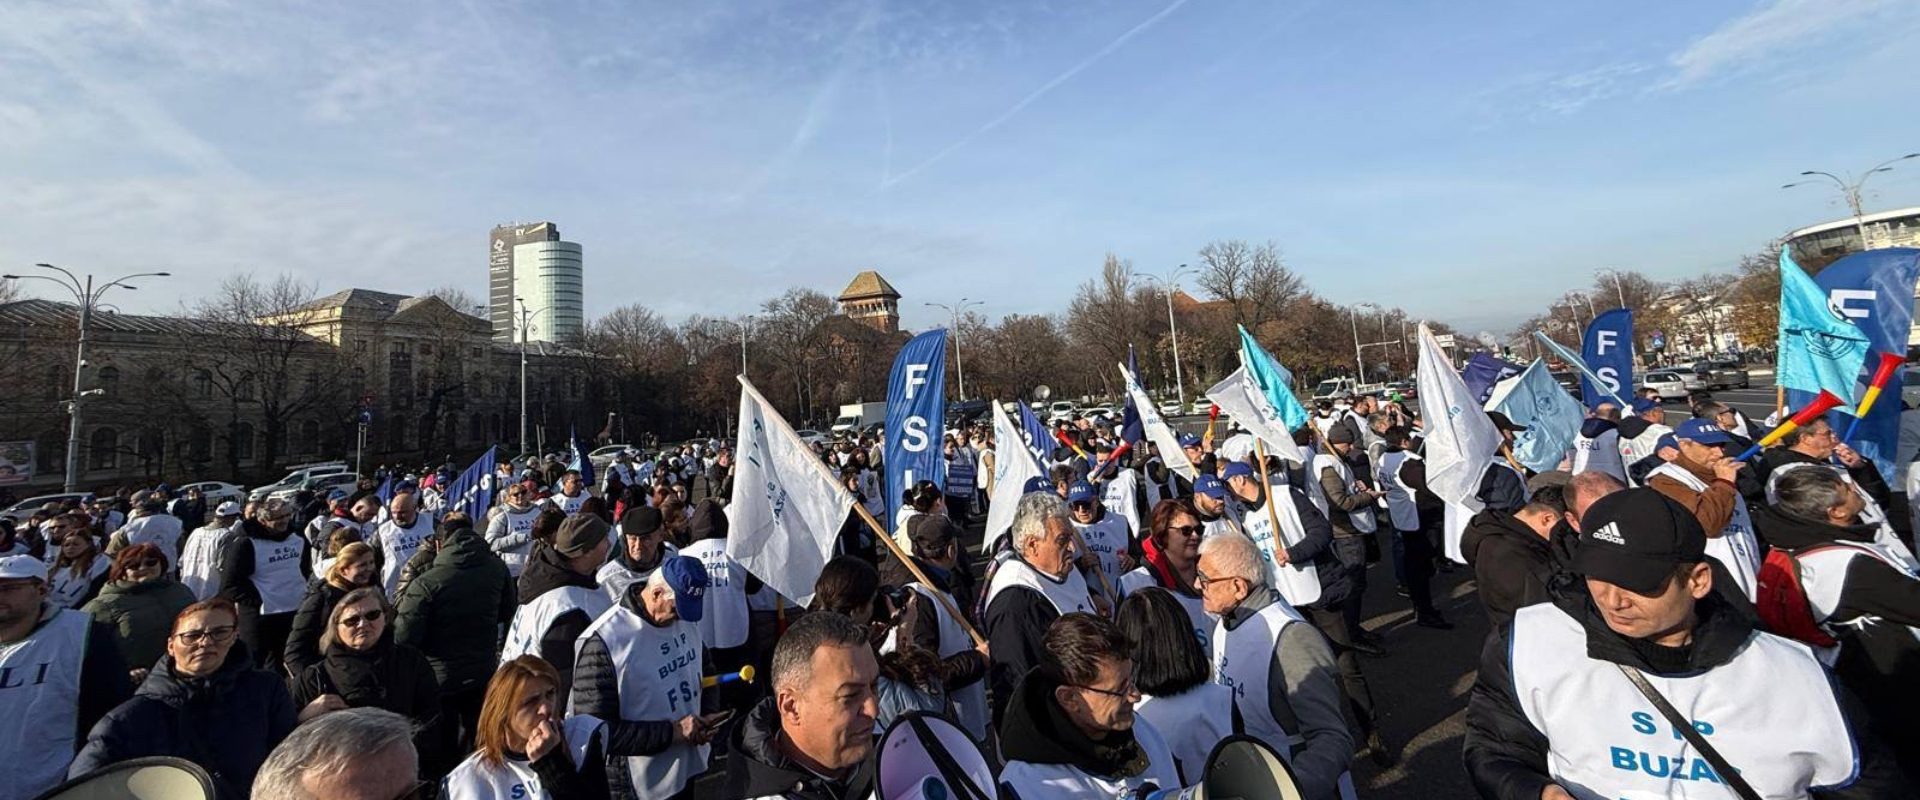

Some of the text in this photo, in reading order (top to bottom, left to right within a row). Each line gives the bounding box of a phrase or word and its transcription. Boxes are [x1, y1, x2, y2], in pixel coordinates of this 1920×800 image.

[1592, 532, 1626, 545] adidas
[702, 550, 723, 559] SIP
[660, 632, 686, 656] SIP
[1610, 746, 1742, 786] BUZA
